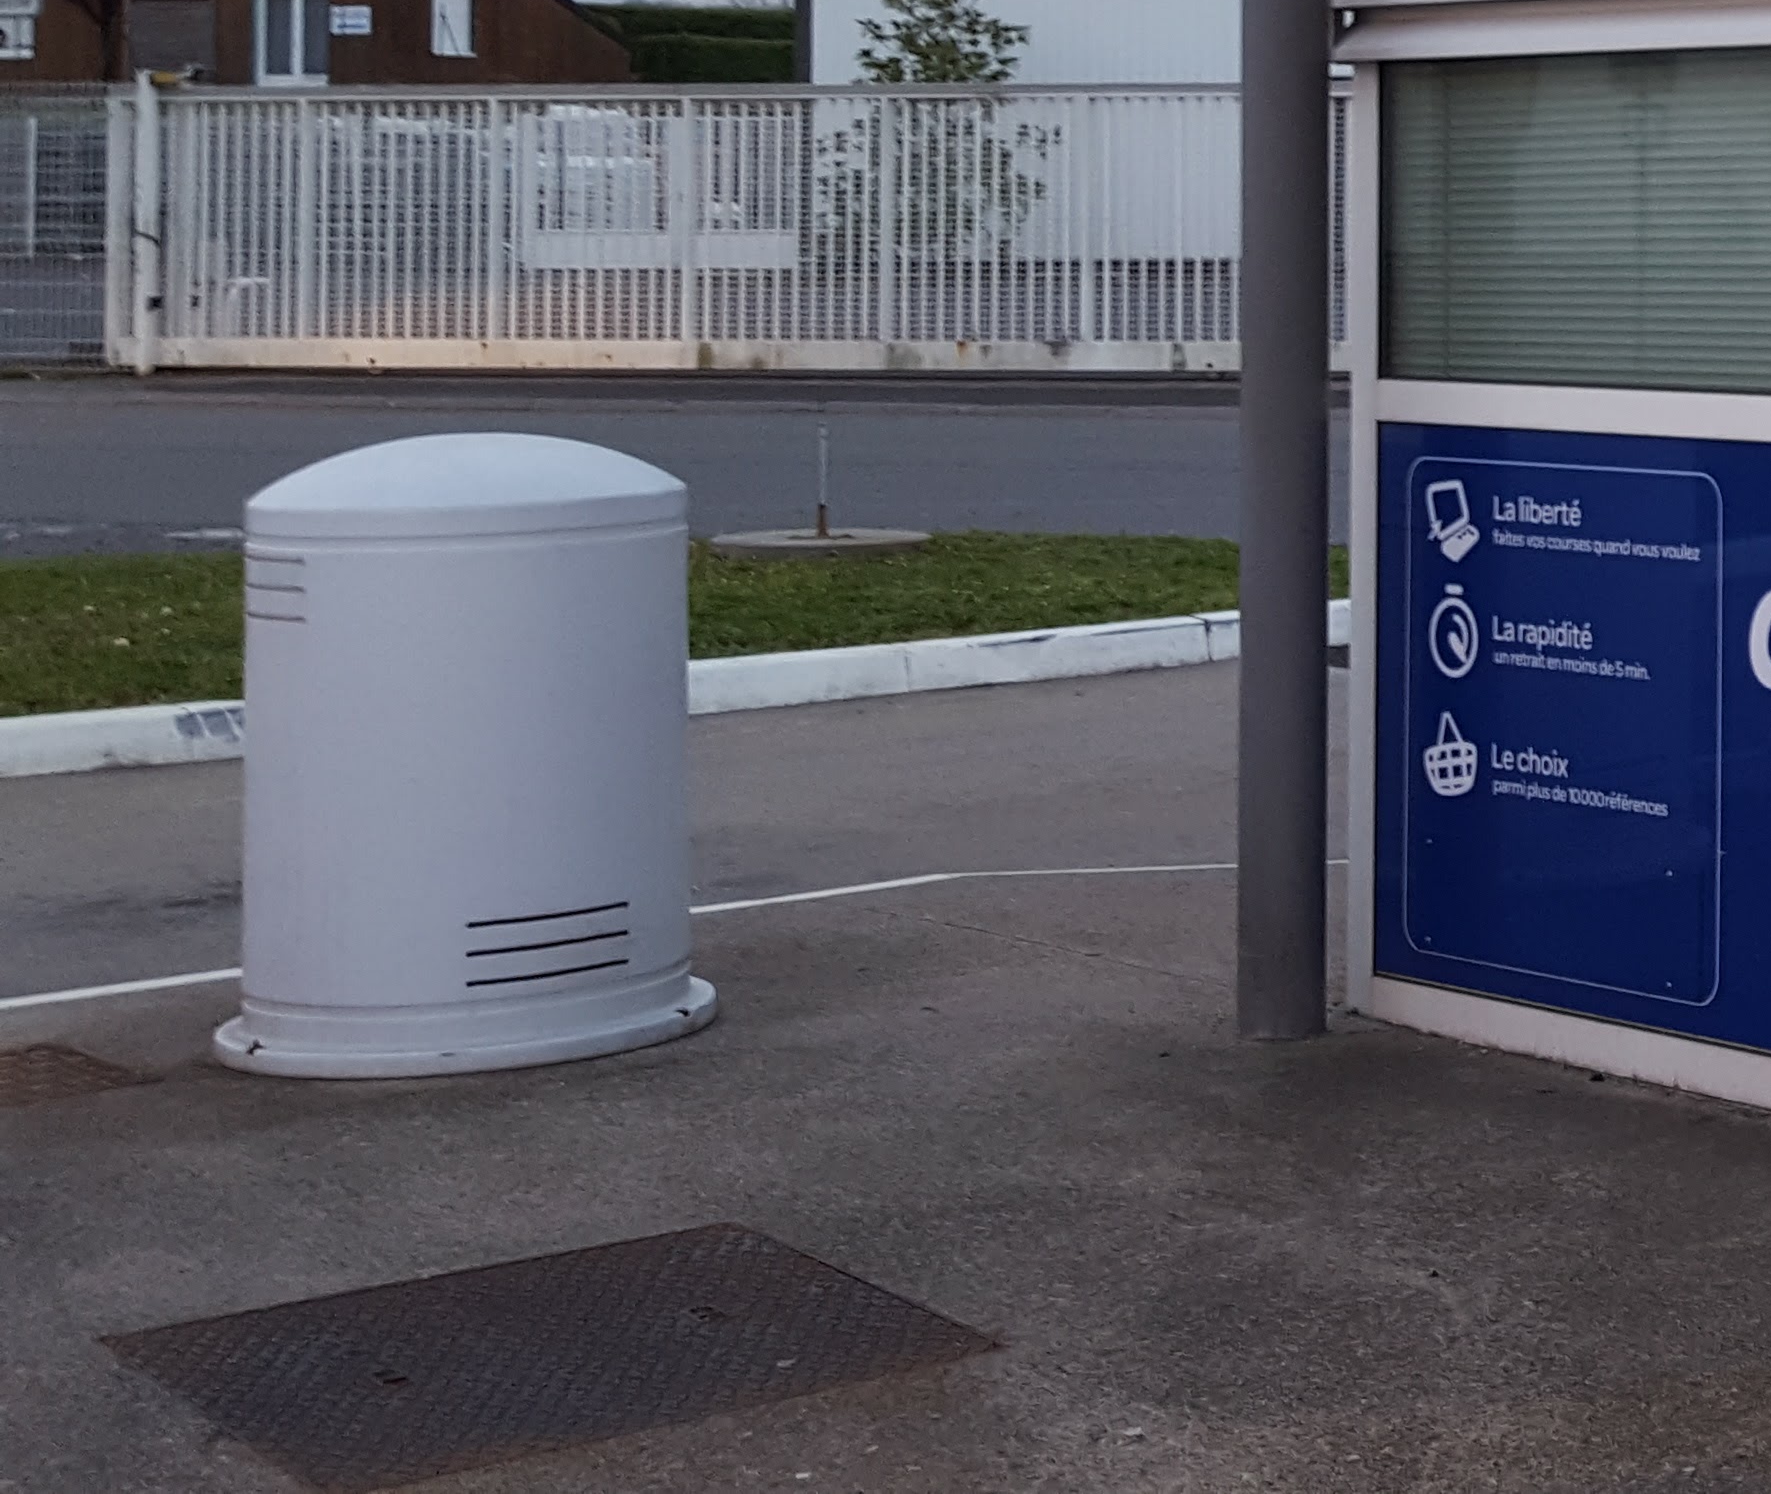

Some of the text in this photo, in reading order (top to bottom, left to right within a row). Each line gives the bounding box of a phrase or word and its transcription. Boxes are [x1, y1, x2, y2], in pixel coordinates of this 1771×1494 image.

[1492, 495, 1582, 527] La liberté
[1492, 528, 1701, 562] faites vos courses quand vous voulez
[1491, 615, 1594, 652] La rapidité
[1510, 652, 1546, 669] retrait
[1547, 657, 1562, 671] en
[1563, 657, 1598, 675] moins
[1600, 659, 1615, 676] de
[1615, 661, 1625, 677] 5
[1625, 662, 1651, 680] min.
[1490, 742, 1569, 779] Le choix
[1493, 780, 1526, 796] parmi
[1527, 782, 1551, 801] plus
[1552, 785, 1567, 803] de
[1605, 791, 1670, 817] références
